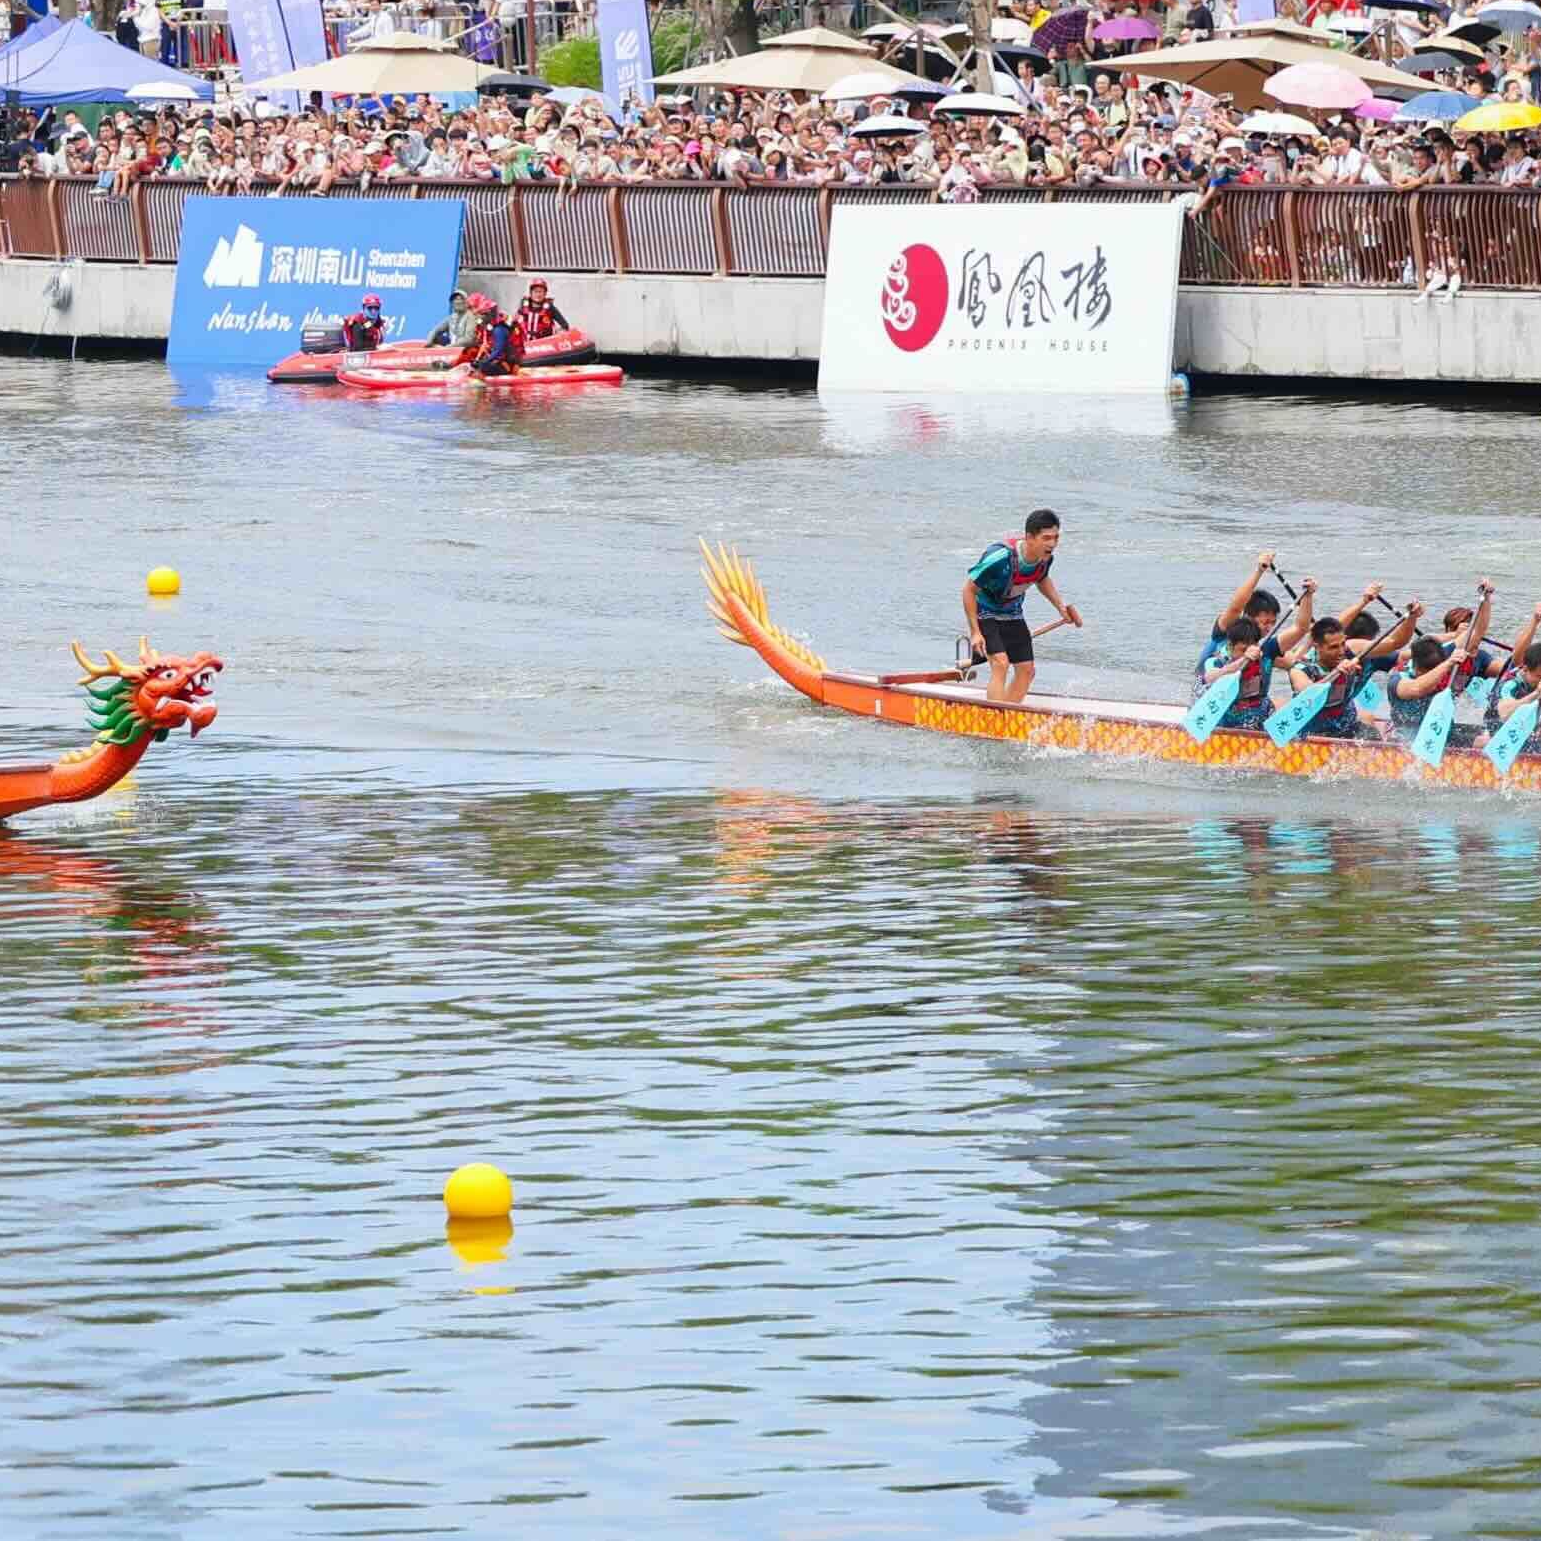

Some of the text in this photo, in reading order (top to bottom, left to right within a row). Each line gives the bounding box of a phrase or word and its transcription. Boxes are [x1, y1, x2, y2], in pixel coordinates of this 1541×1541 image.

[268, 245, 364, 287] 深圳南山
[367, 248, 427, 268] Shenzhen
[365, 269, 417, 289] Nanshan
[206, 300, 294, 335] Nanshan
[948, 338, 1109, 352] PHOENIX HOUSE
